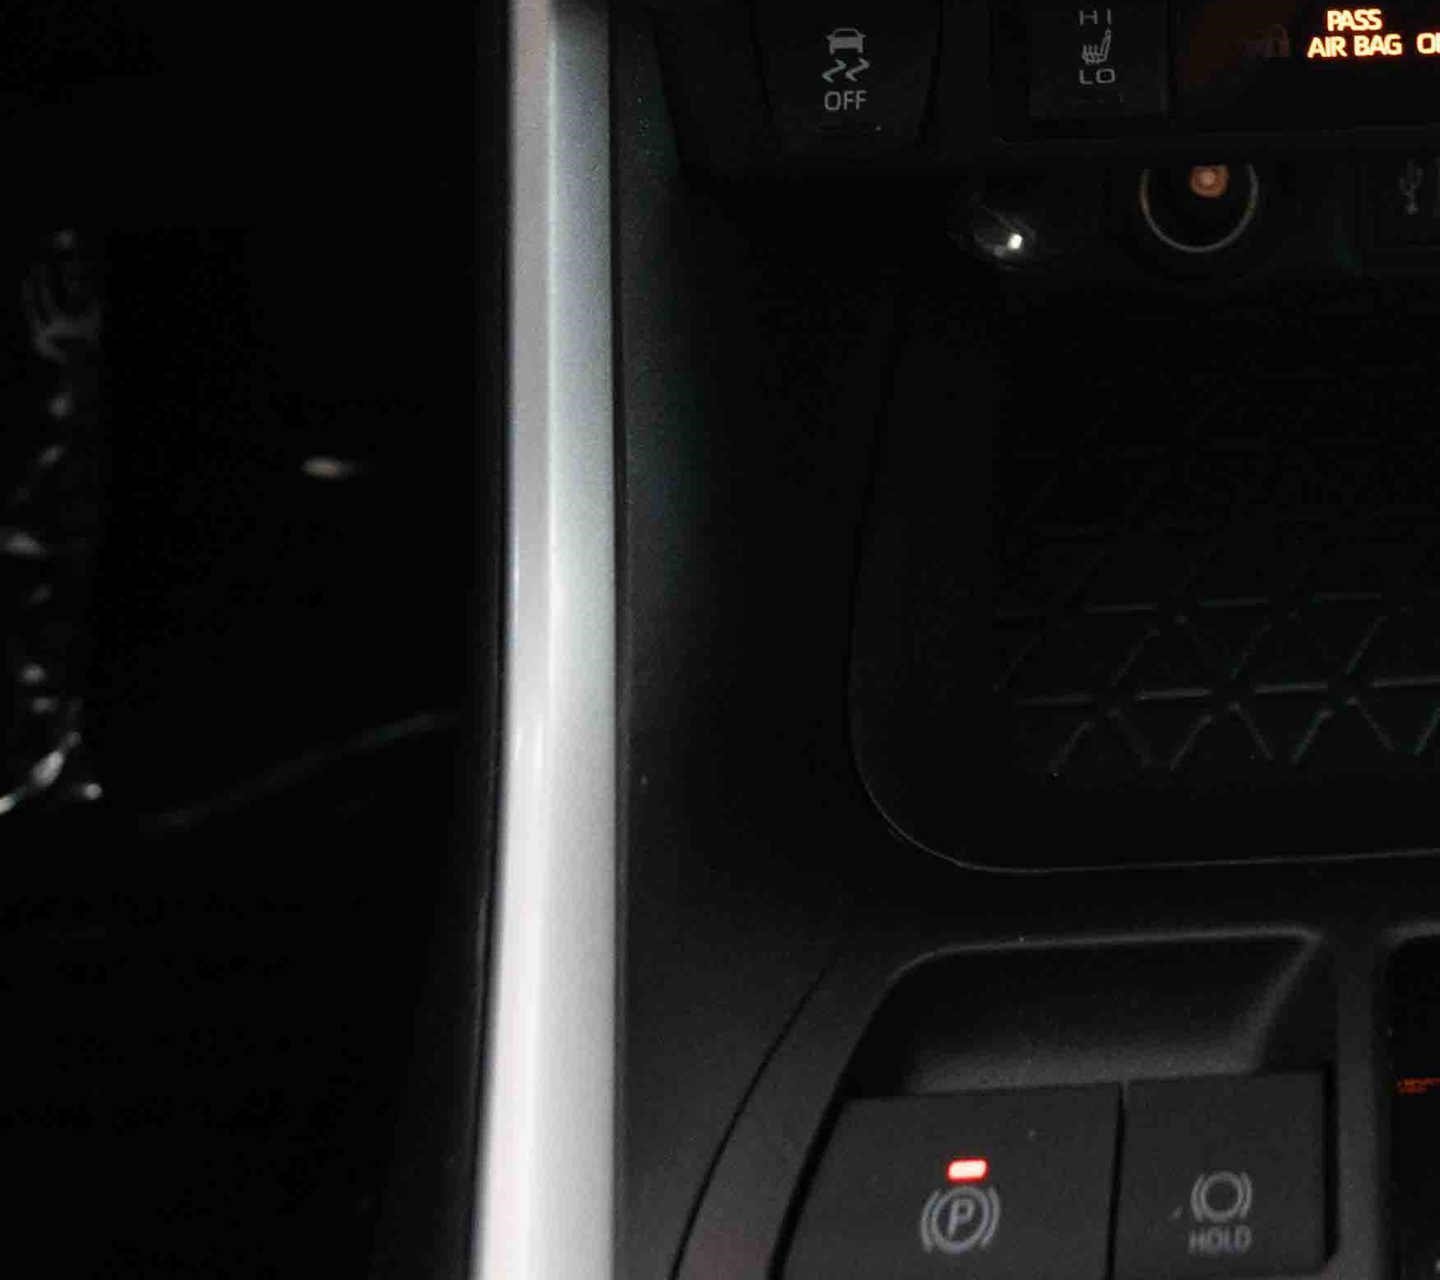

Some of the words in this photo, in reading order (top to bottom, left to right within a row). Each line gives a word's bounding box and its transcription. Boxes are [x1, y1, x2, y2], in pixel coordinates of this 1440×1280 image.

[1078, 8, 1113, 26] HI
[1327, 8, 1383, 32] PASS
[1307, 35, 1347, 58] AIR
[1353, 33, 1403, 57] BAG
[1079, 68, 1116, 86] LO
[824, 91, 867, 112] OFF
